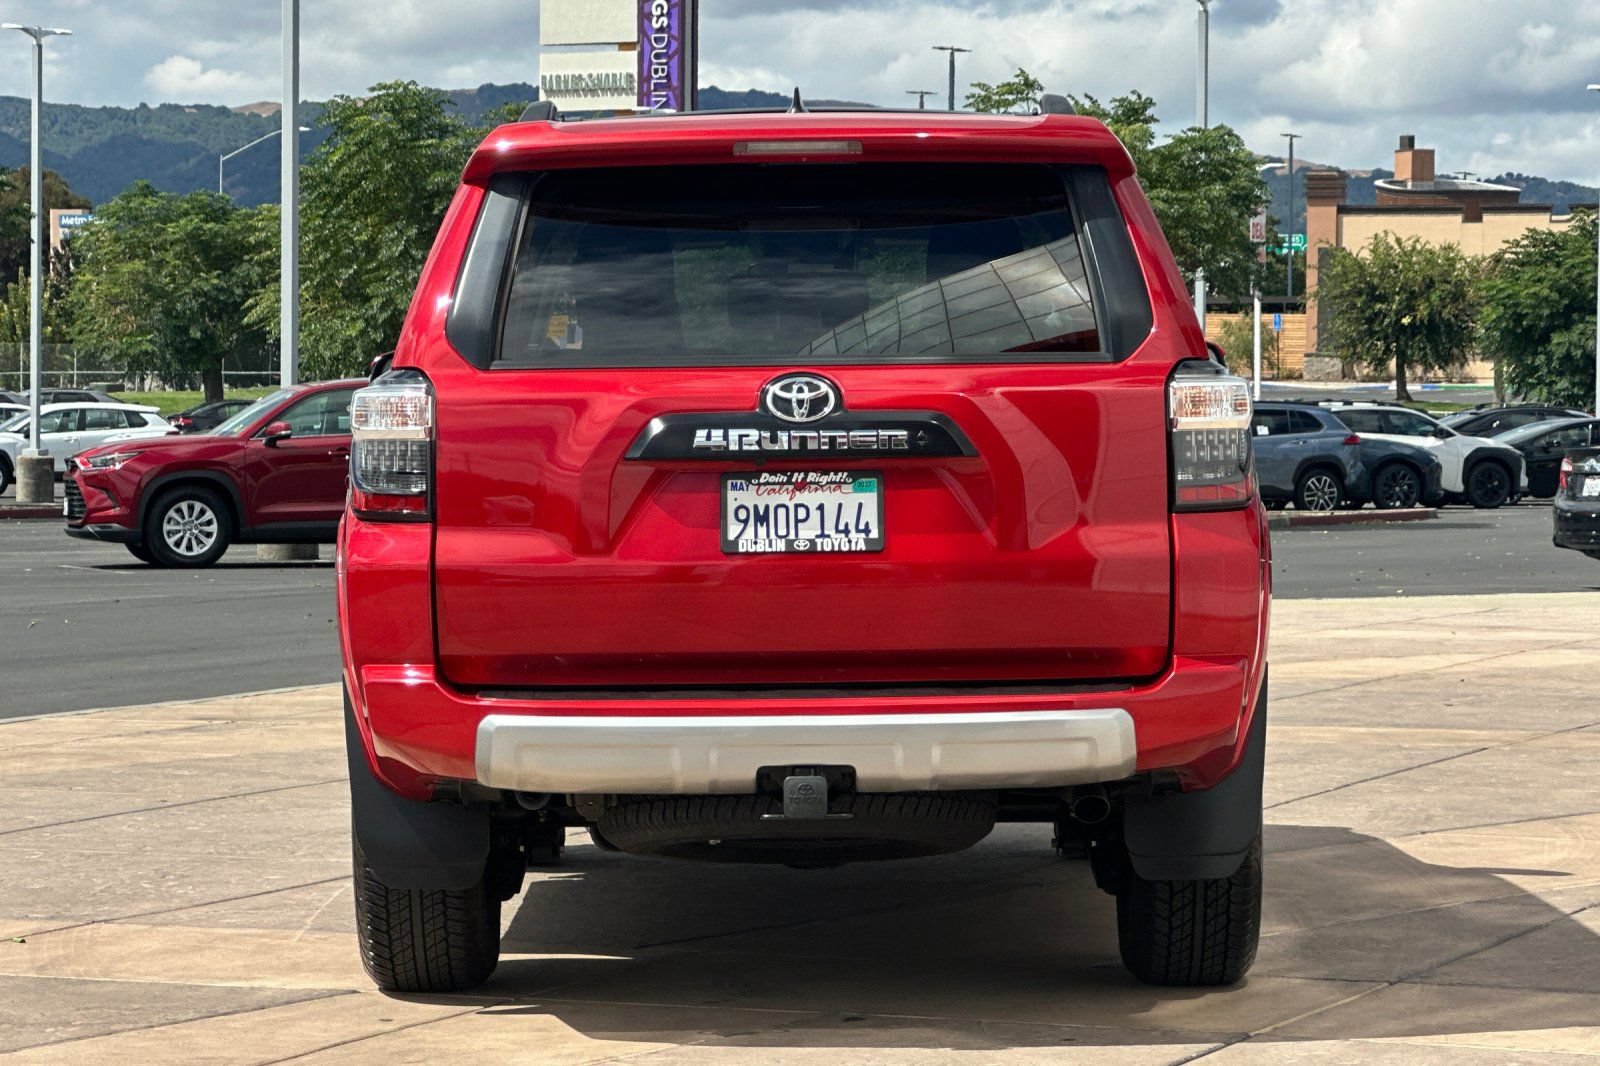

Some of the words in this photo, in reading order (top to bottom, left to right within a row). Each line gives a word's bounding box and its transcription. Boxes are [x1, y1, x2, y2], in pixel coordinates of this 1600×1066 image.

[541, 73, 583, 90] BARNES
[585, 72, 597, 90] &
[597, 72, 636, 90] NOBLE
[760, 472, 790, 483] Doin'
[792, 472, 805, 483] It
[807, 472, 847, 486] Right!
[730, 481, 750, 492] MAY
[734, 502, 871, 539] 9MOP144
[738, 539, 786, 552] DUBLIN
[815, 538, 866, 552] TOYOTA
